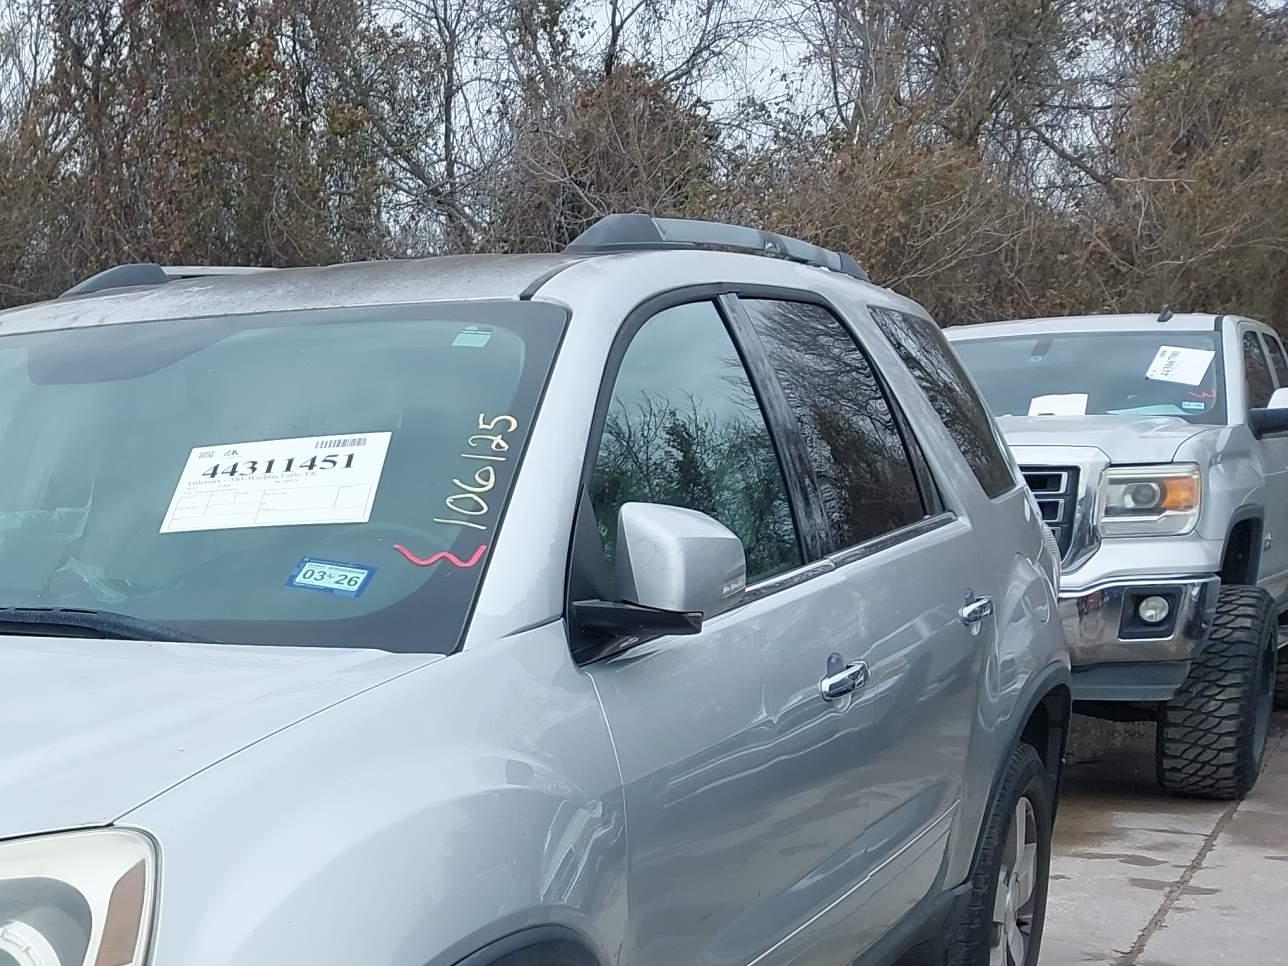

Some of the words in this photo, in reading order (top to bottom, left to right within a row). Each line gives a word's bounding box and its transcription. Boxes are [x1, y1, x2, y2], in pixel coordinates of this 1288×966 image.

[201, 452, 356, 479] 44311451
[432, 413, 519, 530] 106125
[302, 568, 327, 582] 03
[333, 573, 362, 588] 26
